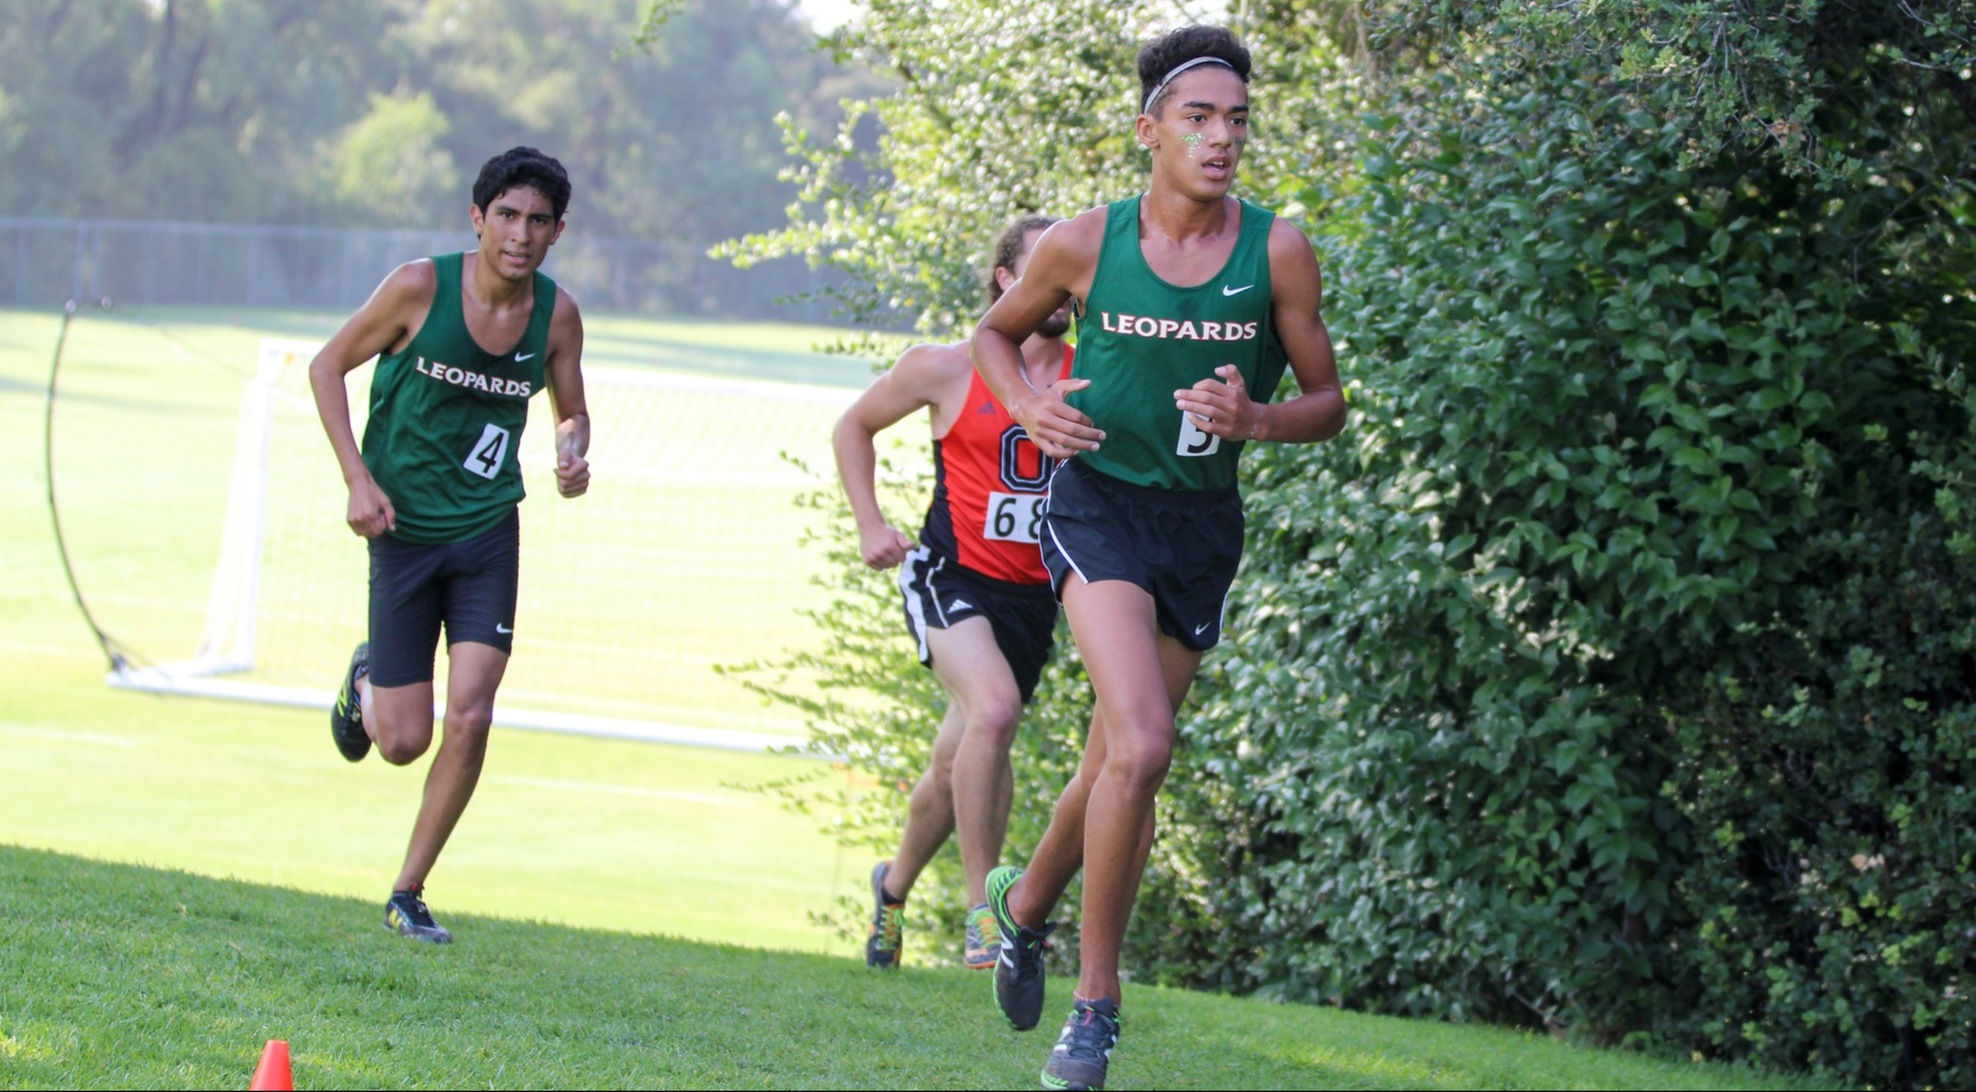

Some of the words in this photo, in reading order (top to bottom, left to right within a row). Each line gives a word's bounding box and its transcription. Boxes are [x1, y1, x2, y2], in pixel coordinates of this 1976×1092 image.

[1101, 311, 1258, 341] LEOPARDS
[416, 356, 531, 397] LEOPARDS
[476, 432, 504, 474] 4
